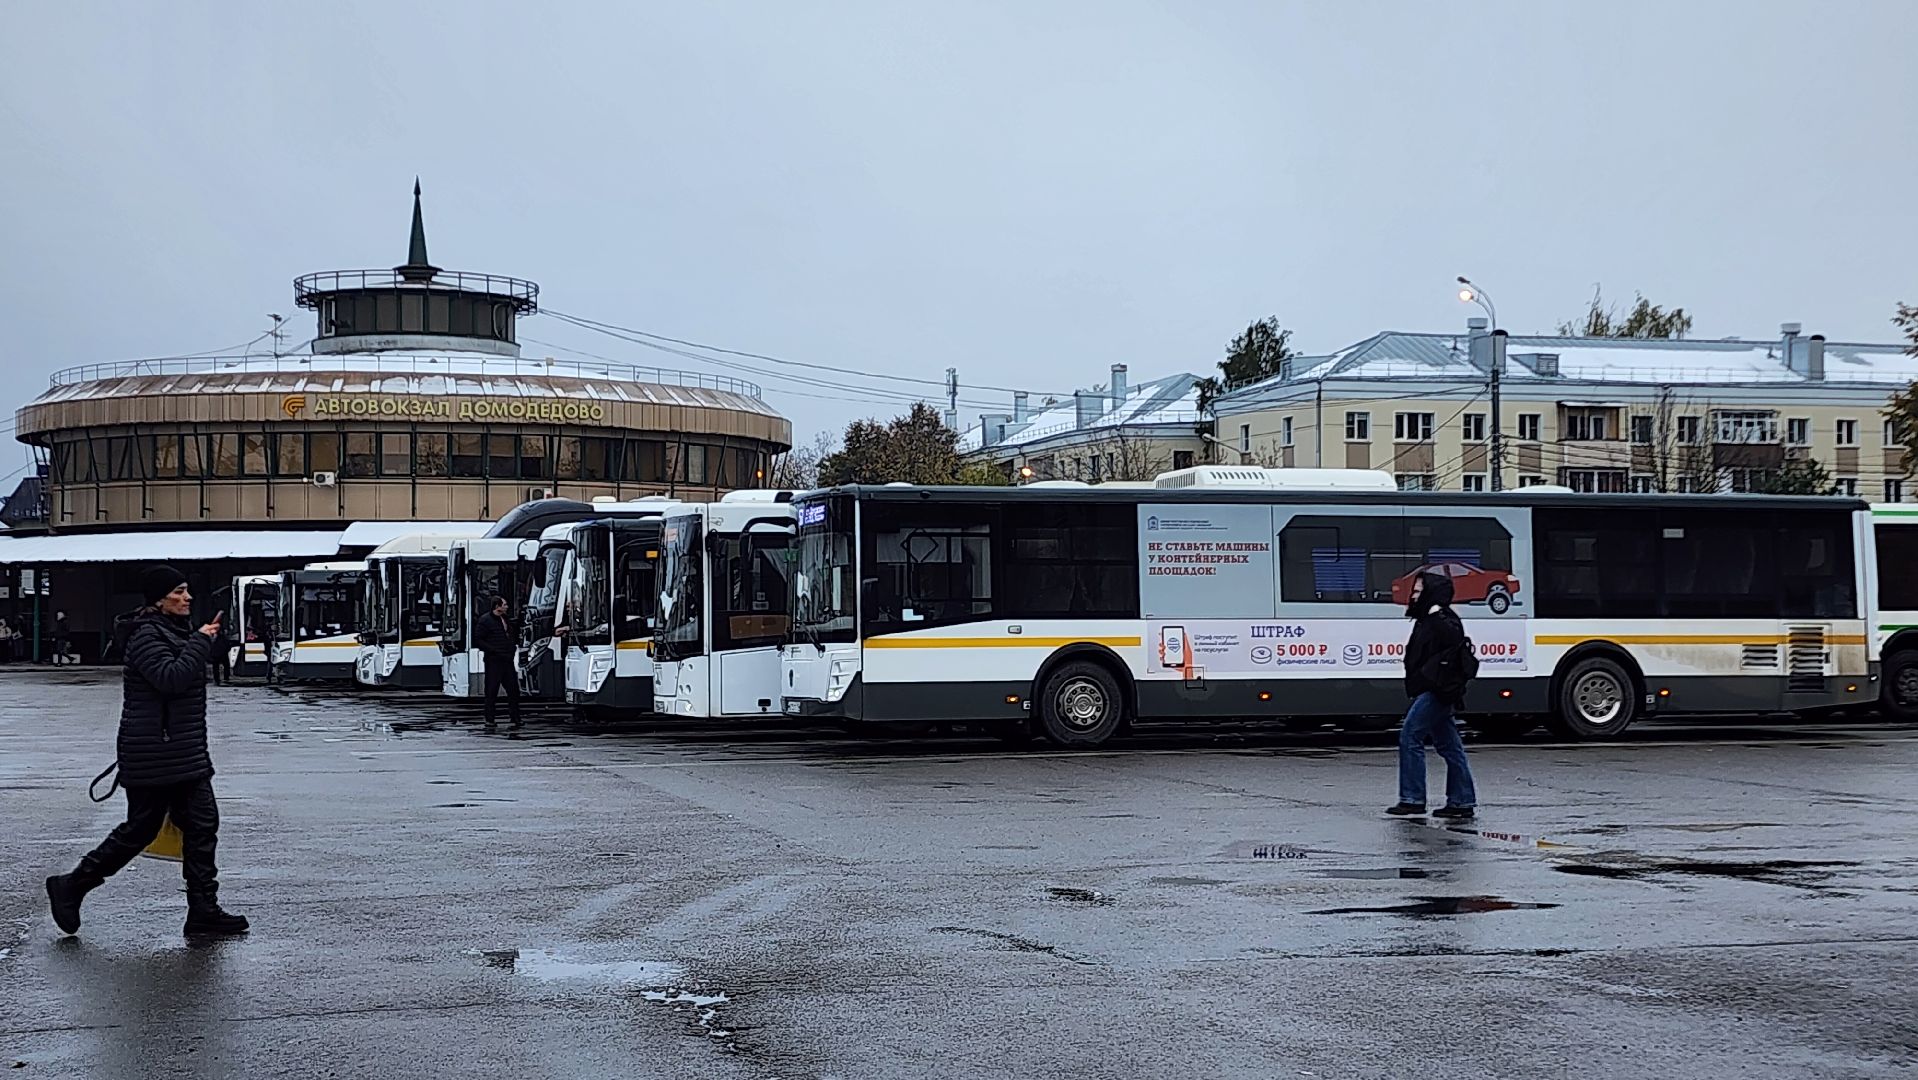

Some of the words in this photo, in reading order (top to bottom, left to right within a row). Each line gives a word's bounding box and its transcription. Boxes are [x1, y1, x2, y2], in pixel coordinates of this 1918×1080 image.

[314, 398, 450, 417] АВТОВОКЗАЛ
[458, 400, 605, 421] ДОМОДЕДОВО
[1148, 542, 1163, 551] НЕ
[1165, 542, 1213, 551] СТАВЬТЕ
[1215, 542, 1270, 552] МАШИНЫ
[1148, 554, 1156, 564] У
[1157, 553, 1250, 564] КОНТЕЙНЕРНЫХ
[1148, 566, 1217, 577] ПЛОЩАДОК!
[1250, 625, 1306, 638] ШТРАФ
[1276, 644, 1286, 656] 5
[1289, 644, 1316, 656] 000
[1367, 643, 1383, 656] 10
[1387, 643, 1405, 656] 00
[1480, 643, 1506, 656] 000
[1276, 657, 1318, 666] физические
